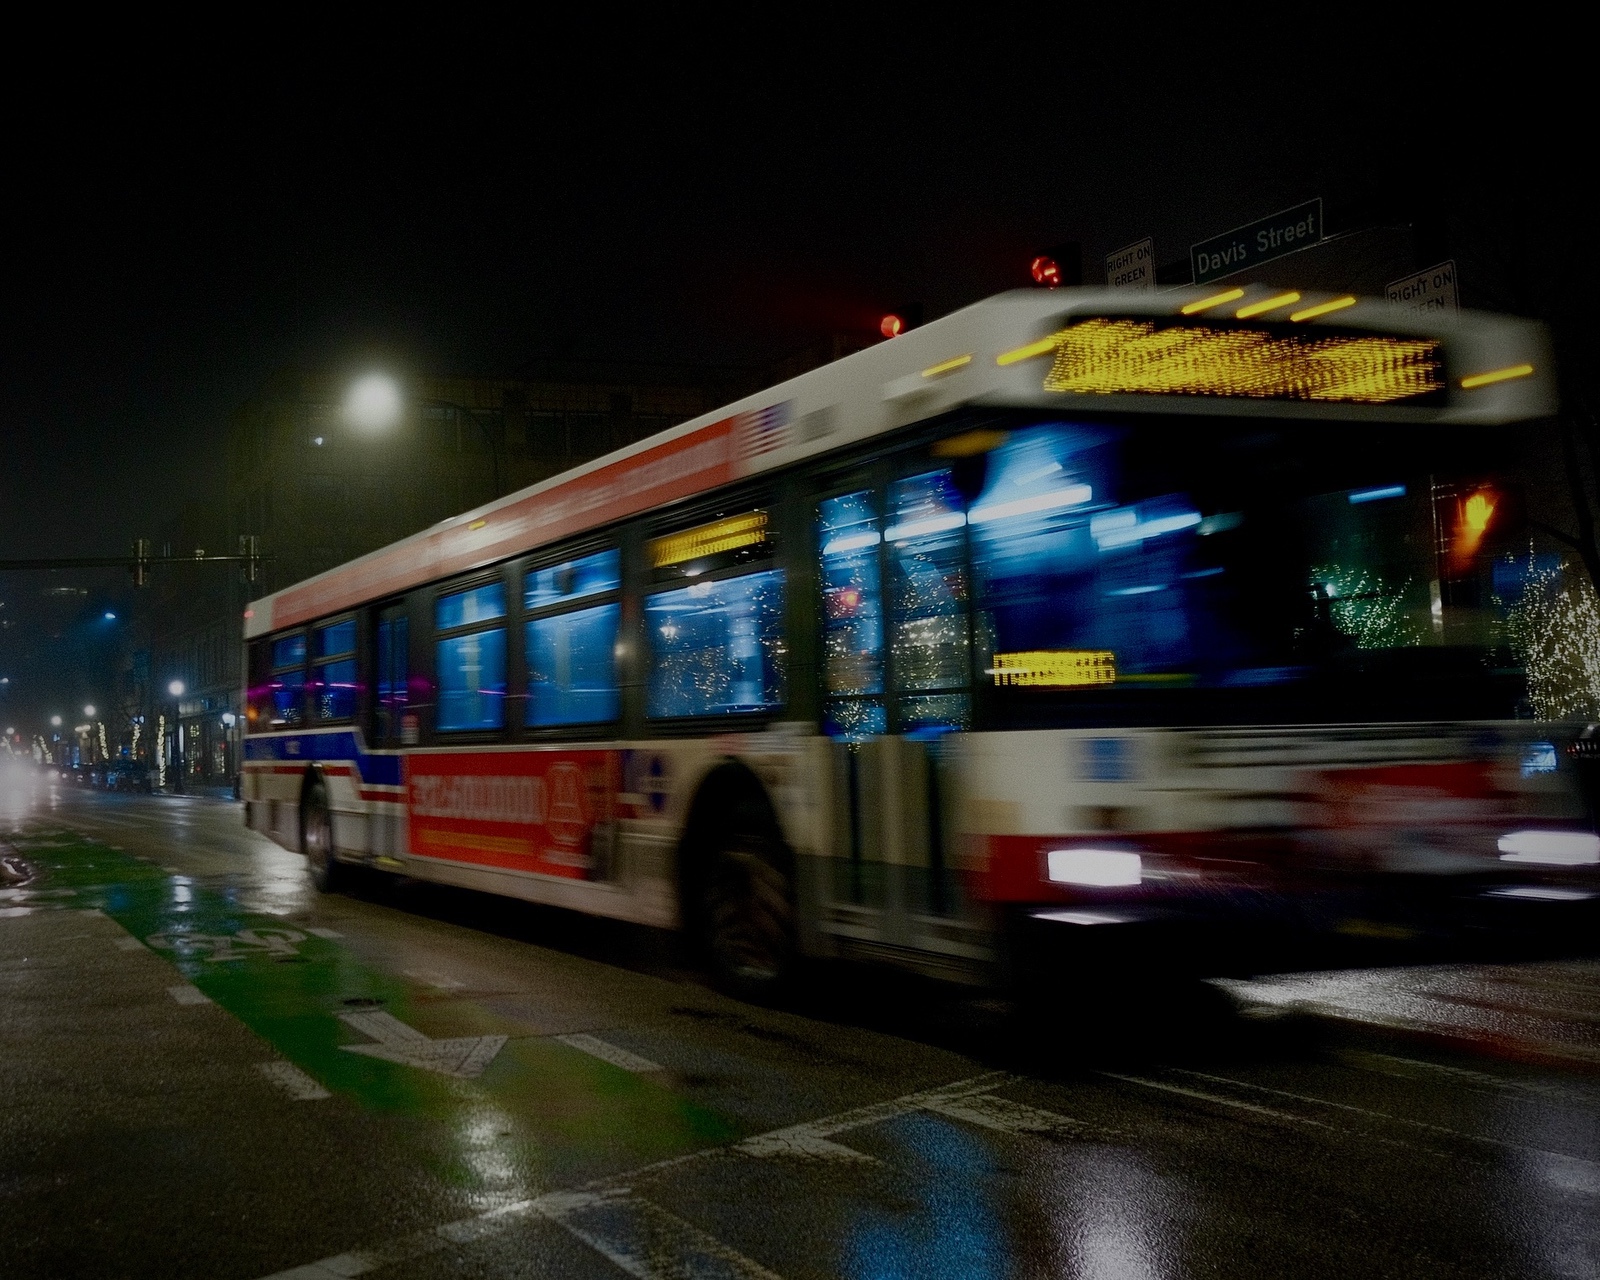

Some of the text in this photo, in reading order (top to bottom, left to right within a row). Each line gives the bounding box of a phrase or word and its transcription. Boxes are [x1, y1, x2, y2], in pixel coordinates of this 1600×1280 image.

[1107, 245, 1151, 273] RIGHT ON
[1197, 212, 1315, 275] Davis Street
[1114, 265, 1146, 287] GREEN
[1389, 270, 1452, 304] RIGHT ON
